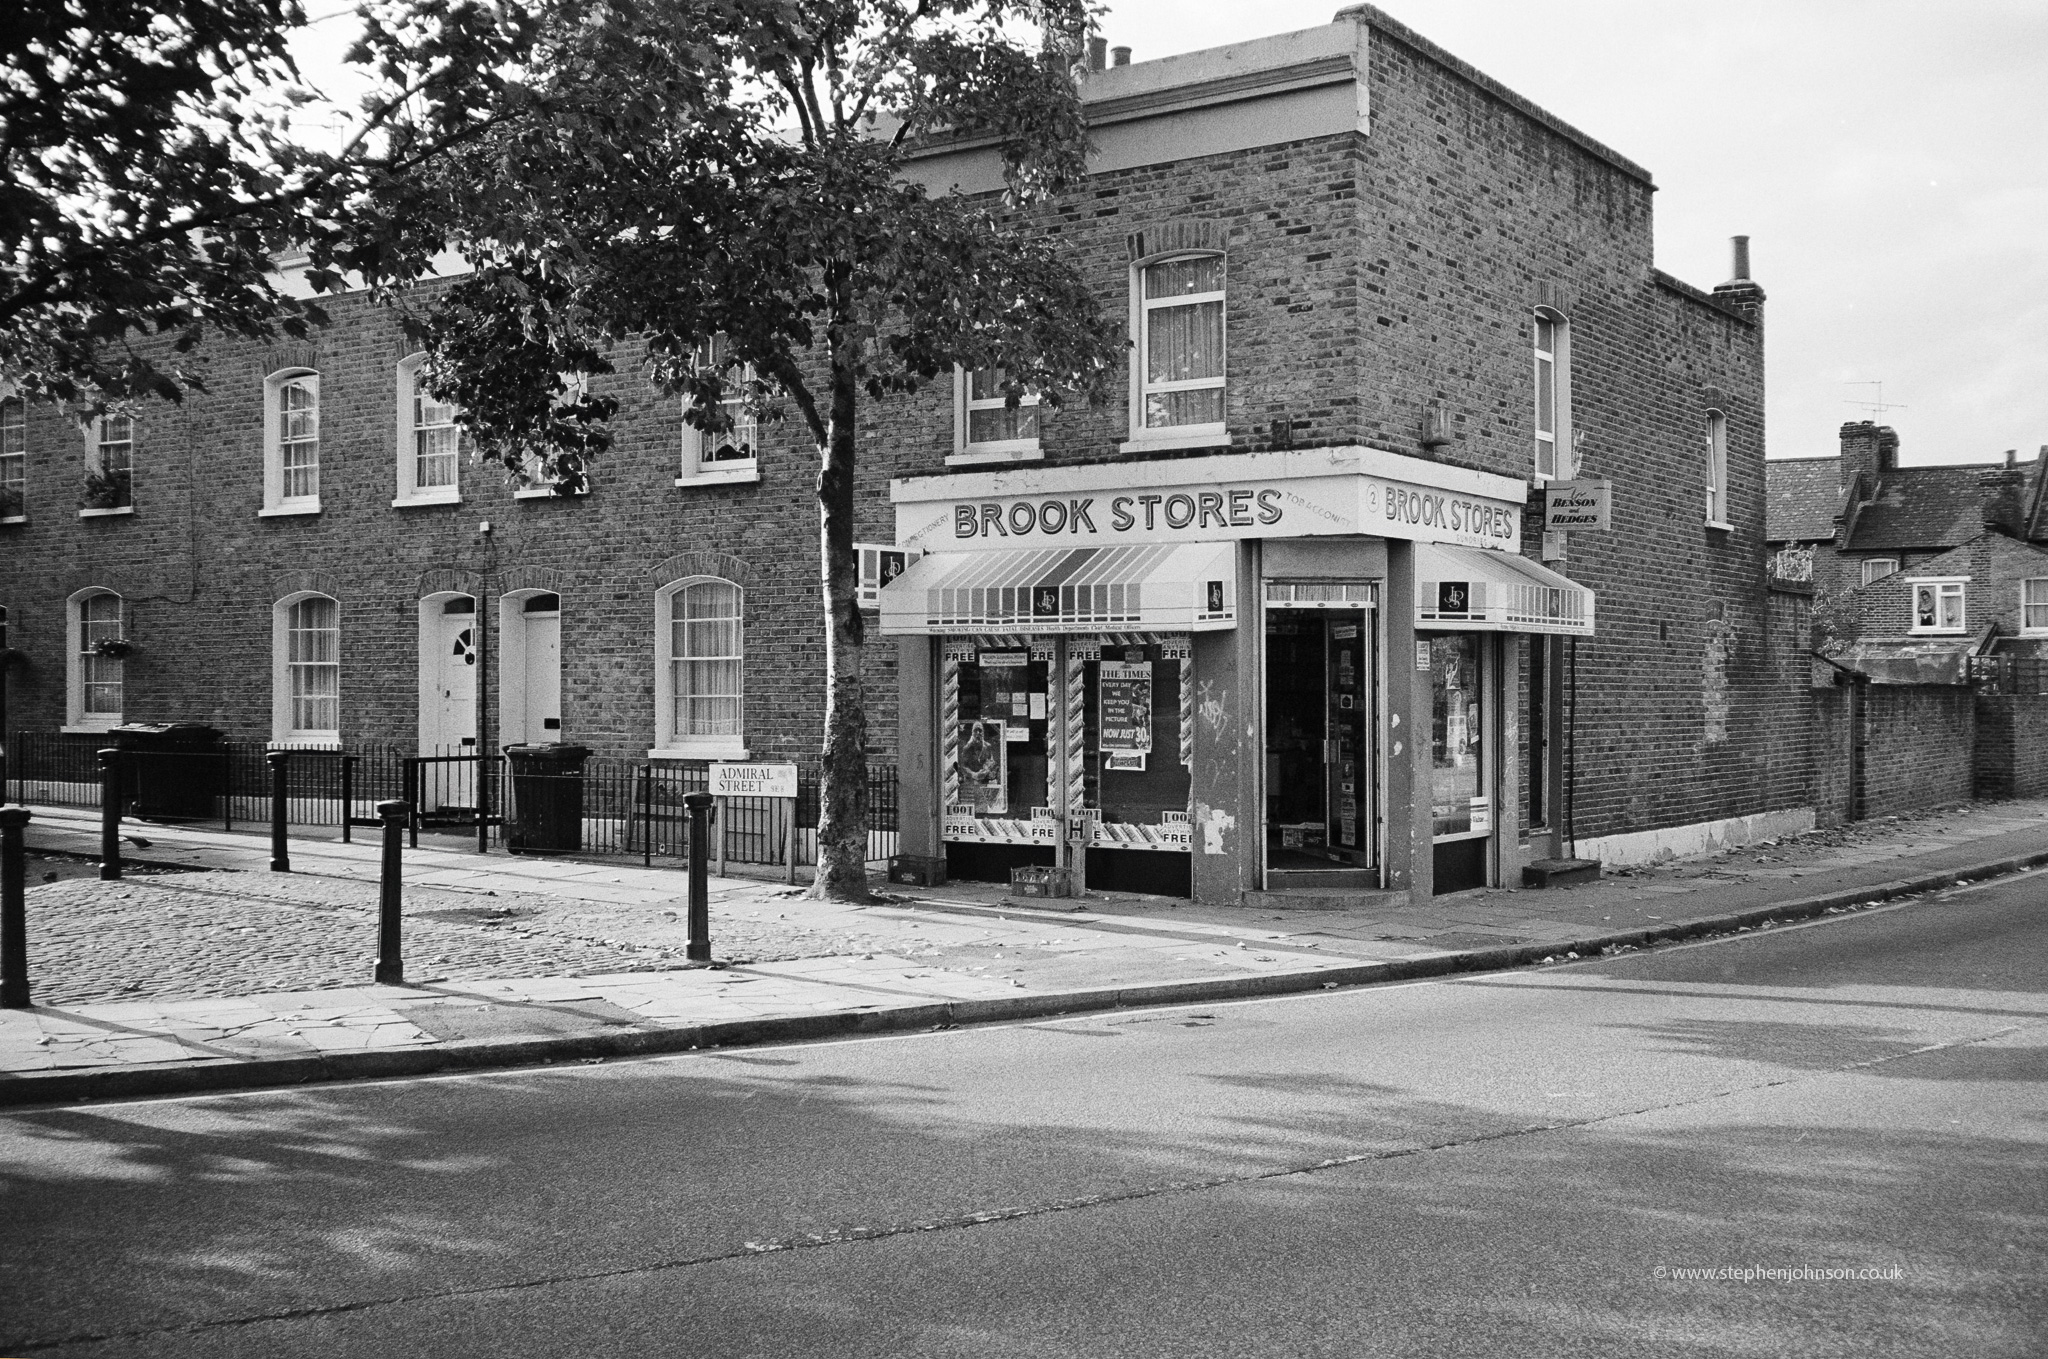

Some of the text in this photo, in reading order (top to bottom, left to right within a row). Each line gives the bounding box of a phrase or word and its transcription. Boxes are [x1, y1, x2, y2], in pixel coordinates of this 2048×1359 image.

[1369, 491, 1377, 504] 2
[1552, 498, 1598, 508] BENSON
[955, 489, 1283, 538] BROOK STORES
[1385, 486, 1513, 539] BROOK STORES
[1551, 514, 1598, 524] HEDGES
[946, 652, 974, 661] FREE
[1031, 651, 1054, 660] FRE
[1069, 651, 1101, 660] FREE
[1102, 669, 1151, 679] THE TIMES
[1103, 728, 1119, 738] NOW
[1119, 729, 1135, 739] JUST
[719, 767, 774, 779] ADMIRAL
[719, 780, 764, 792] STREET
[946, 805, 973, 816] LOOT
[1033, 808, 1055, 818] LOO
[945, 825, 974, 834] FREE
[1032, 829, 1054, 838] FRE
[1069, 819, 1084, 839] H
